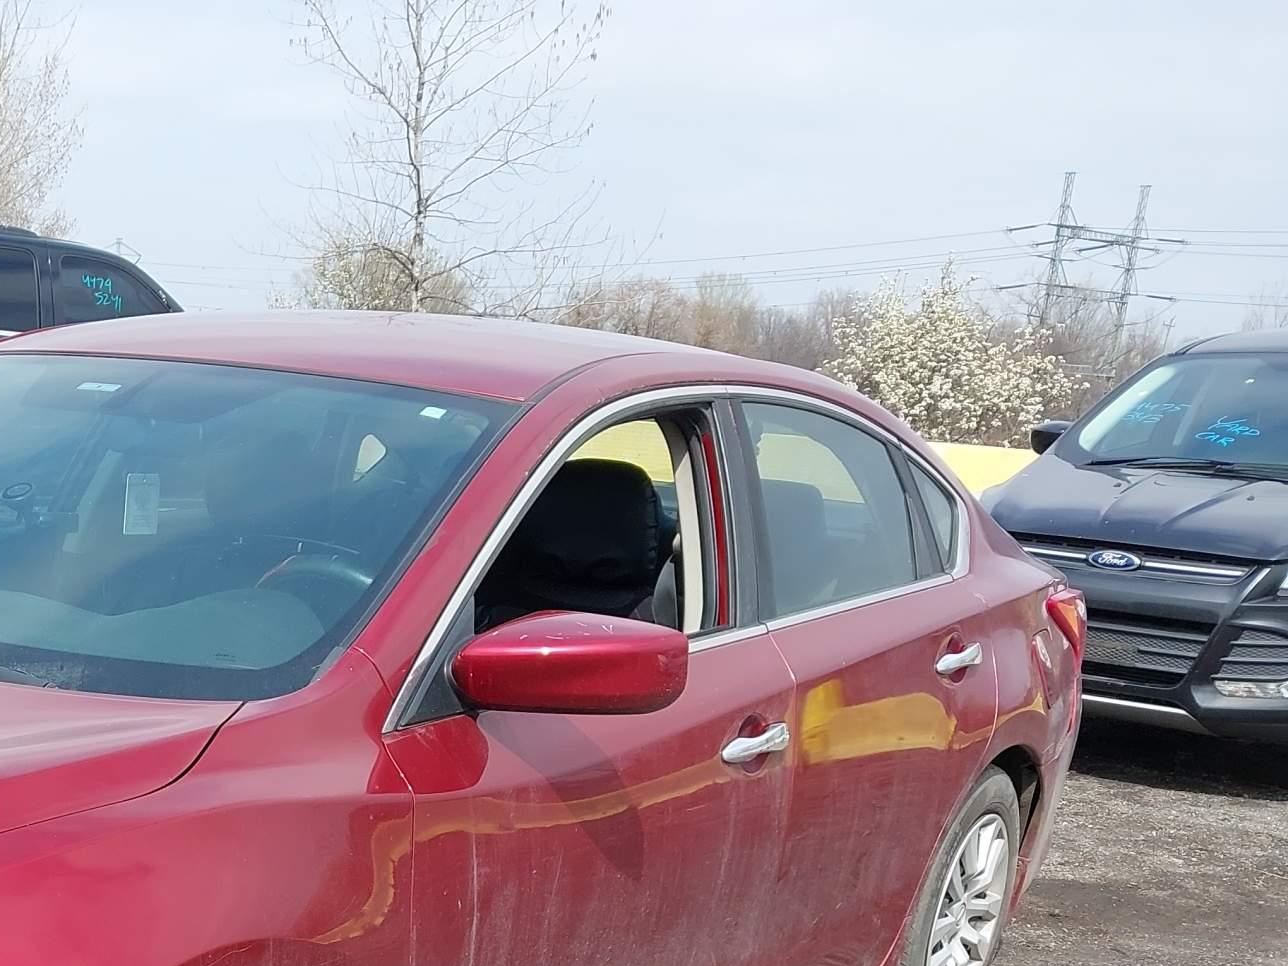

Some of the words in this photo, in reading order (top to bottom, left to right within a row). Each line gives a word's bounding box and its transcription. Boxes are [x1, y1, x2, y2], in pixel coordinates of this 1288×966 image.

[81, 273, 112, 294] 4479
[94, 291, 122, 313] 5241
[1207, 416, 1262, 437] YARD
[1195, 431, 1236, 447] CAR
